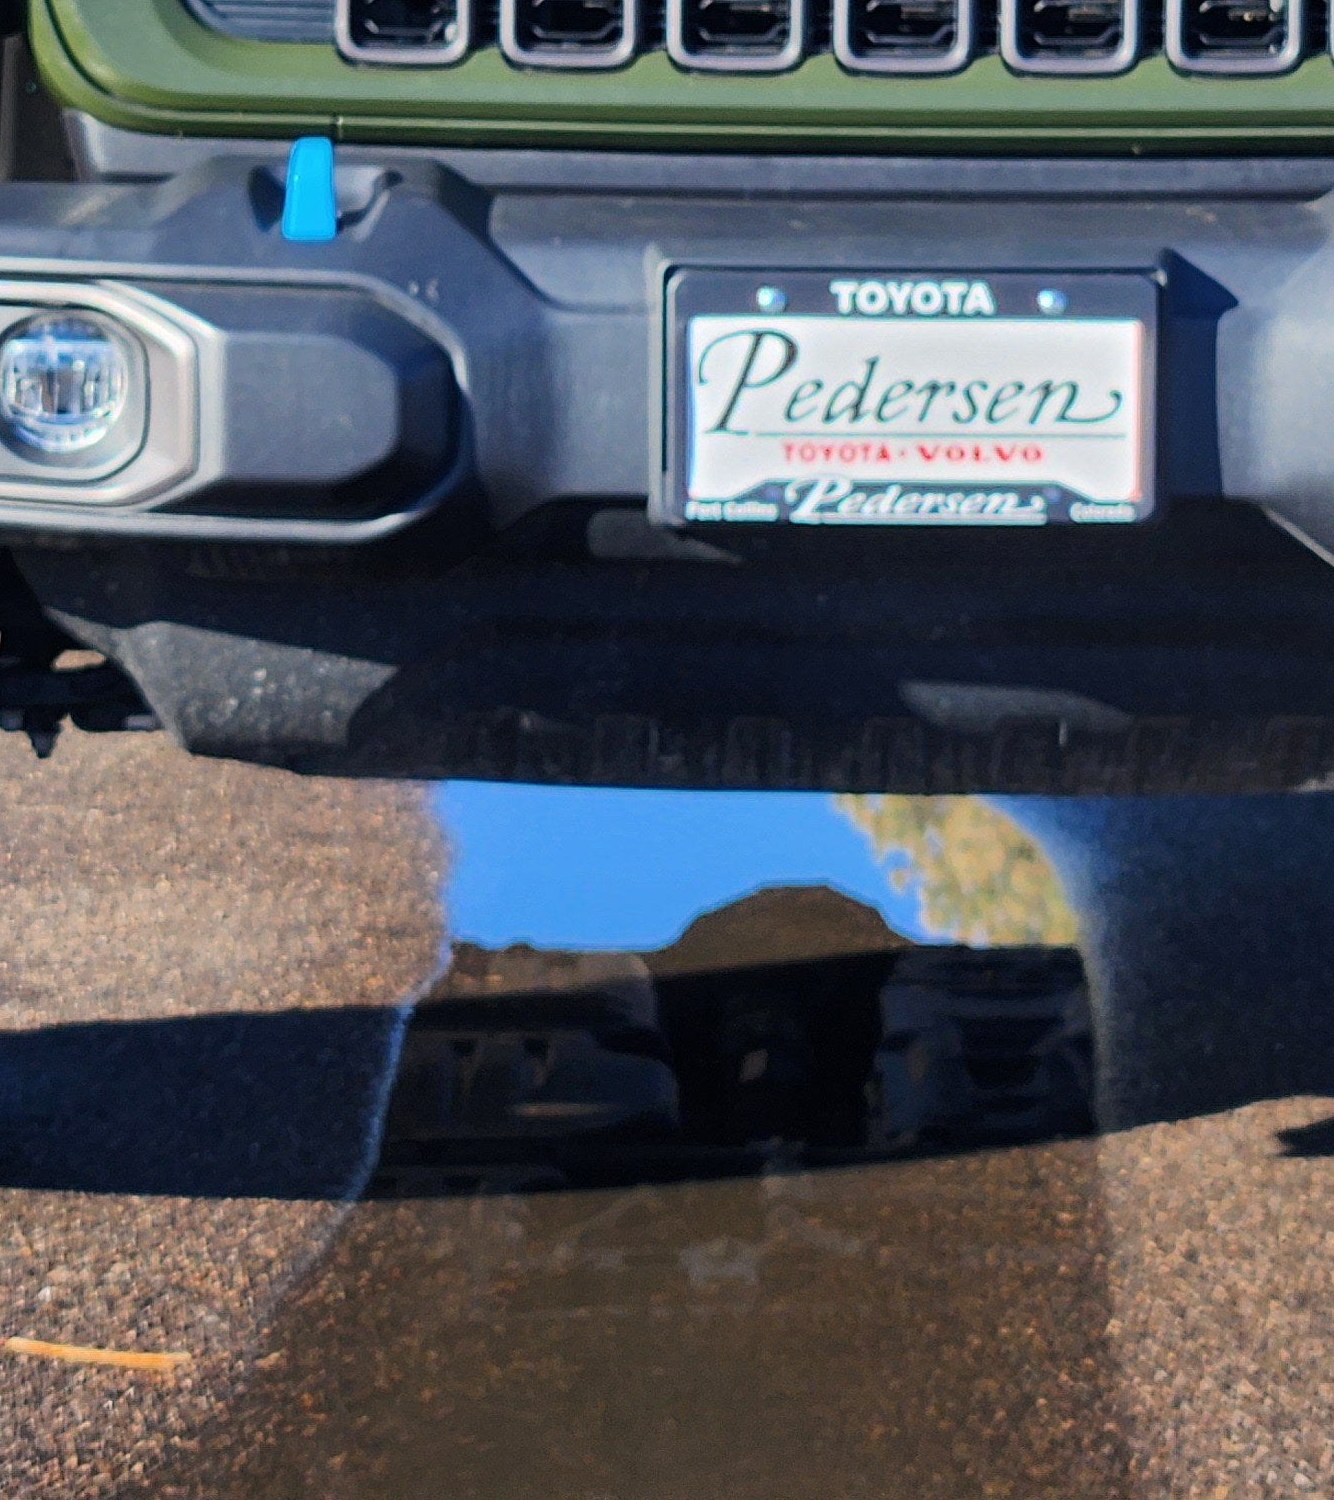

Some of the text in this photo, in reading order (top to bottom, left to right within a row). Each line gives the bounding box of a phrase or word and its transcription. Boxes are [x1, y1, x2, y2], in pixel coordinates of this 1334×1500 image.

[830, 281, 996, 316] TOYOTA
[698, 329, 1123, 434] Pedersen
[783, 443, 1044, 463] TOYOTA VOLVO
[785, 476, 1047, 524] Pedersen
